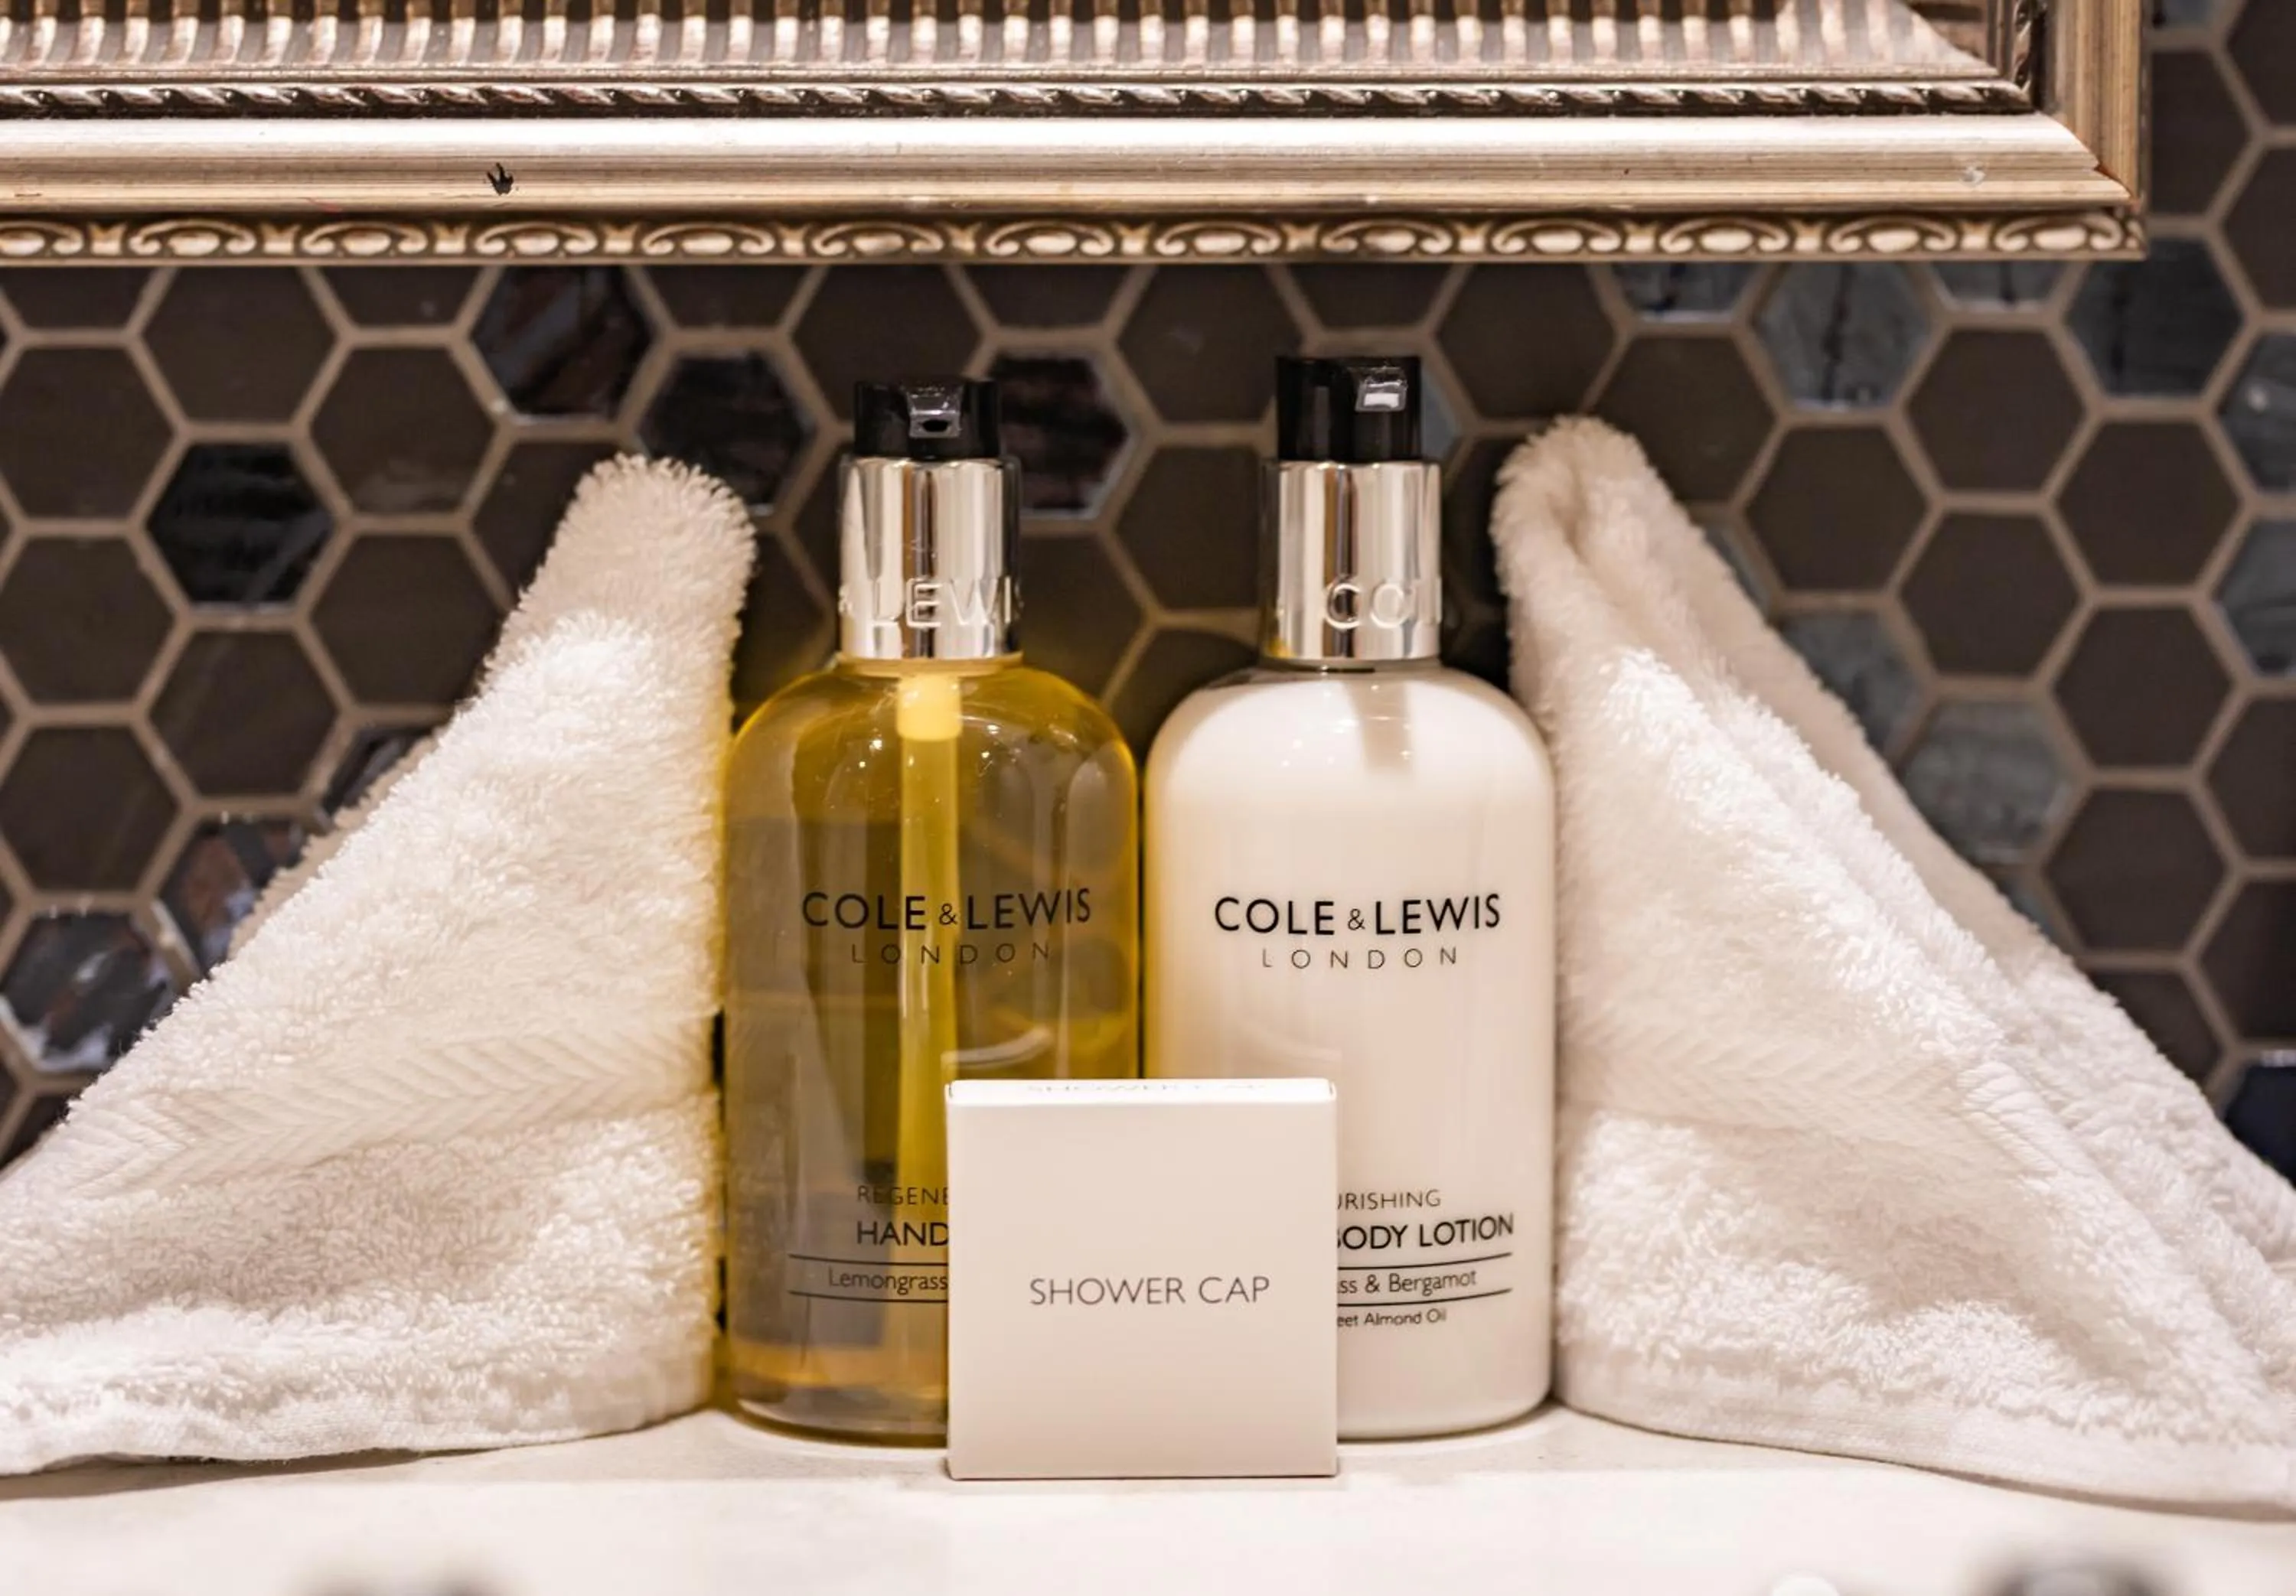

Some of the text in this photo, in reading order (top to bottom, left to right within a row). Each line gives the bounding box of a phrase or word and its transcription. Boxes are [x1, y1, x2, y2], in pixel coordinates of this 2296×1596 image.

[801, 888, 1091, 930] COLE & LEWIS
[1215, 893, 1500, 936] COLE & LEWIS
[852, 942, 1050, 966] LONDON
[1262, 946, 1457, 969] LONDON
[856, 1220, 949, 1246] HAND
[1337, 1212, 1514, 1250] ODY LOTION
[828, 1266, 948, 1295] Lemongrass
[1029, 1276, 1270, 1305] SHOWER CAP
[1337, 1270, 1477, 1297] ss & Bergamot
[1364, 1310, 1422, 1327] Almond
[1426, 1308, 1447, 1324] Oil
